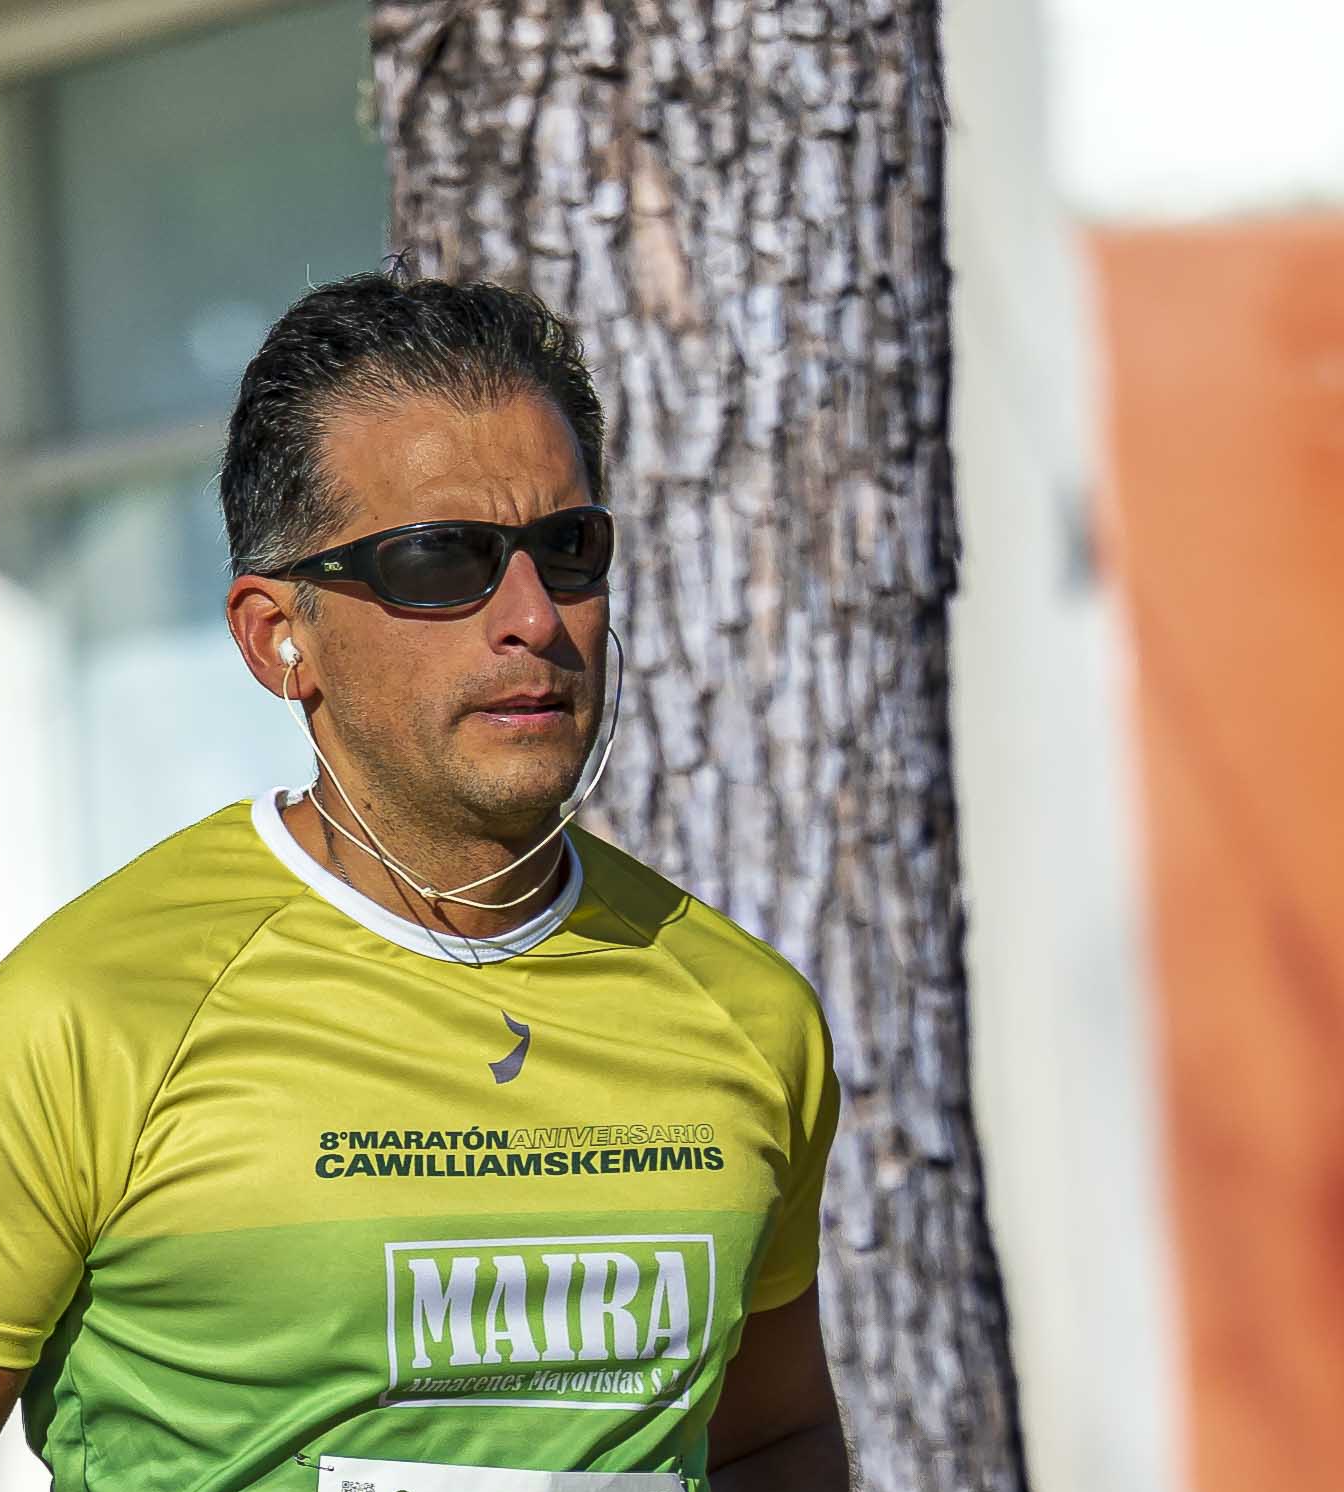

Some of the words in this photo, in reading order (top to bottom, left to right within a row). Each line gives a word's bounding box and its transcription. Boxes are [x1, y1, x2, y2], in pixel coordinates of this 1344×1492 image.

[508, 1123, 714, 1149] ANIVERSARIO
[315, 1147, 725, 1179] CAWILLIAMSKEMMIS
[408, 1251, 690, 1369] MAIRA
[403, 1374, 526, 1392] Almacenes
